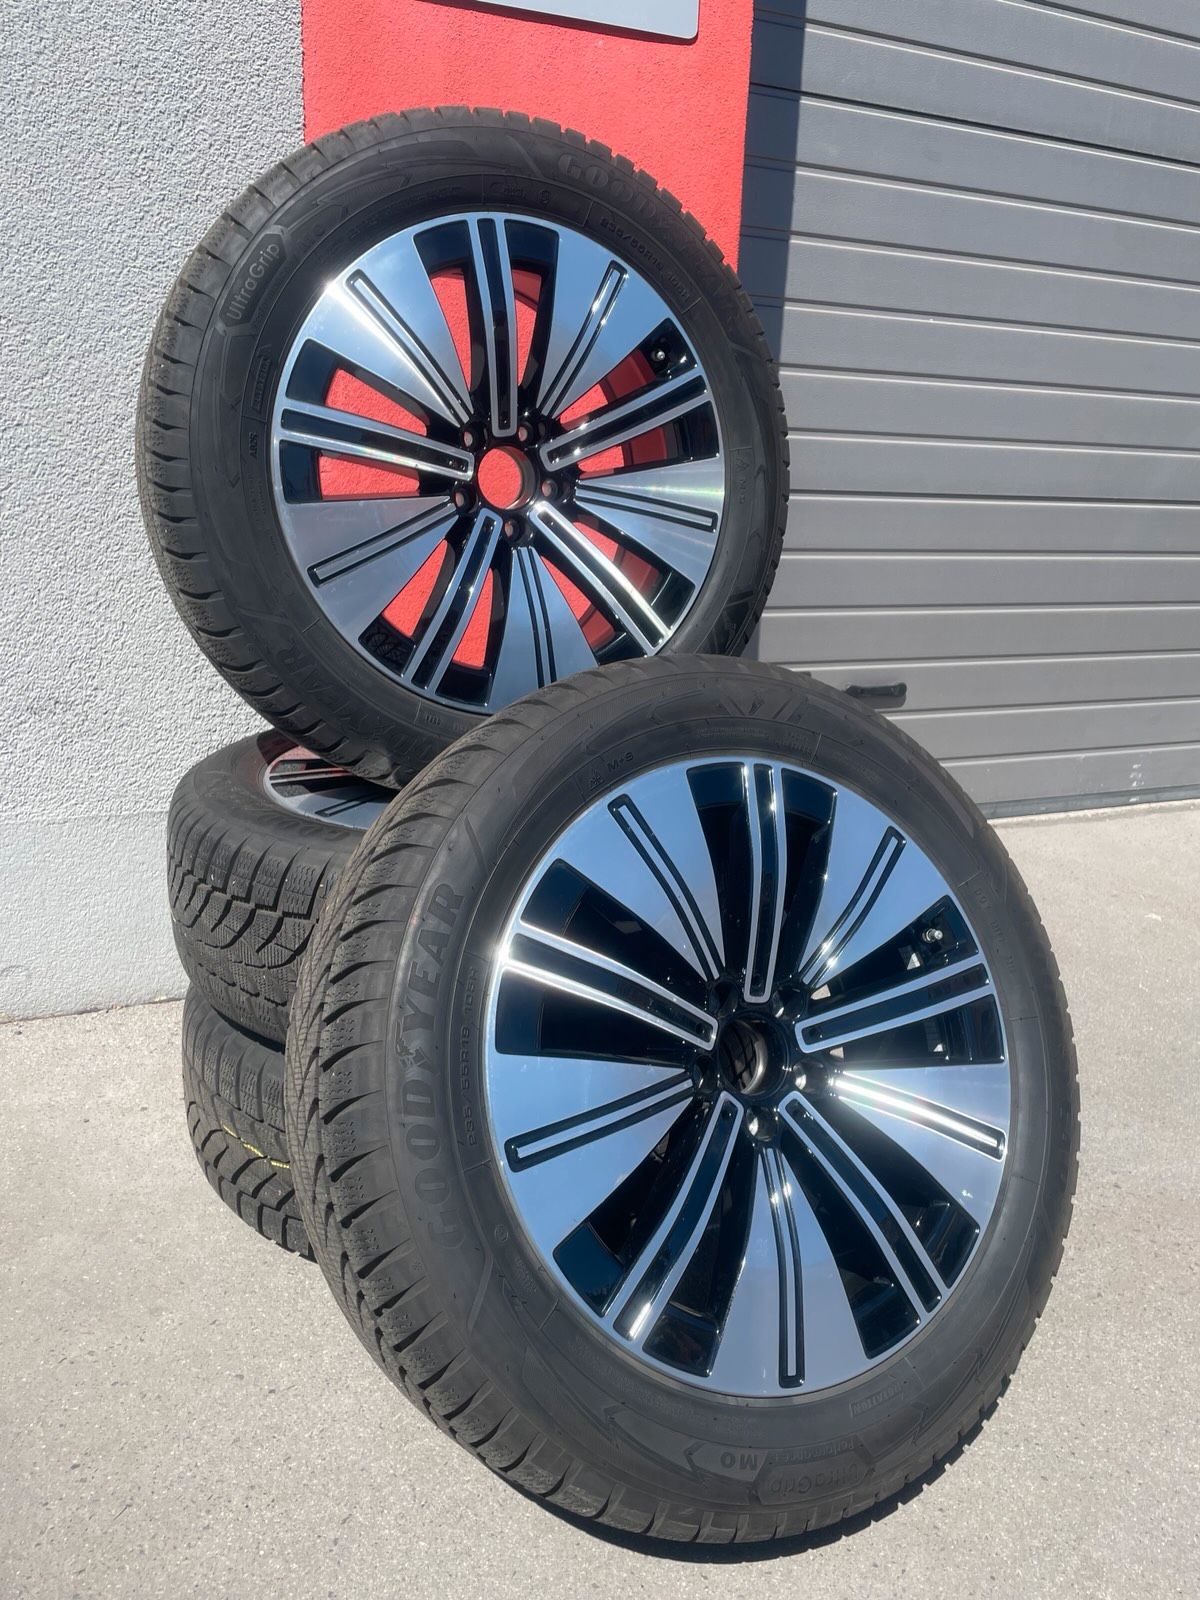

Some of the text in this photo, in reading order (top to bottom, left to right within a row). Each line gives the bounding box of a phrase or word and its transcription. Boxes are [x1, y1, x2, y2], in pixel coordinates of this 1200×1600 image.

[225, 243, 280, 320] UltraGrip
[606, 751, 634, 772] M+S
[397, 882, 467, 1248] GOODYEAR
